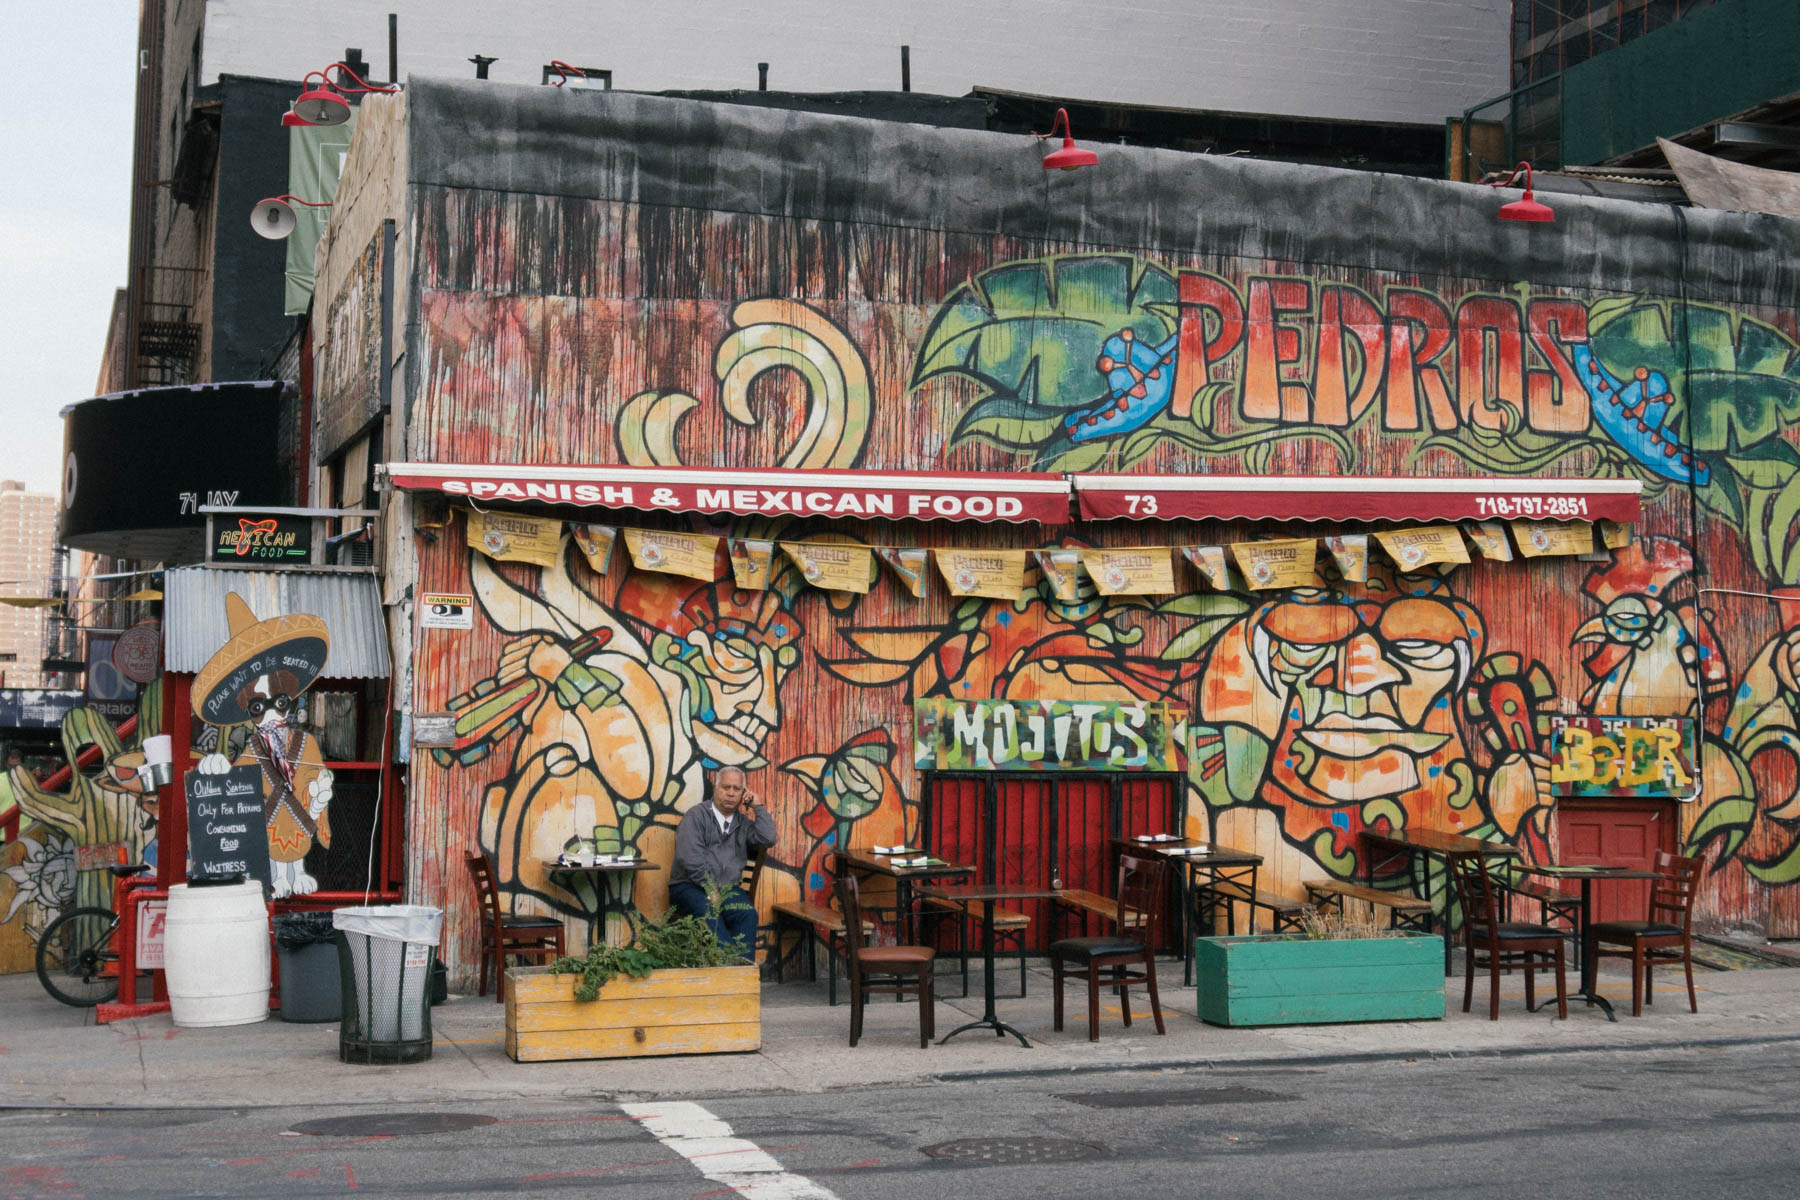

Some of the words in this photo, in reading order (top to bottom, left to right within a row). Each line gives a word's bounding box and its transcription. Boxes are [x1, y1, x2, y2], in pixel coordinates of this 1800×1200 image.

[1169, 270, 1593, 434] PEDROS
[179, 492, 197, 515] 71
[441, 480, 633, 504] SPANISH
[650, 487, 681, 506] &
[696, 488, 893, 514] MEXICAN
[908, 494, 1022, 517] FOOD
[1125, 495, 1158, 515] 73
[1475, 497, 1588, 515] 718-797-2851
[219, 530, 296, 547] MEXICAN
[251, 547, 284, 557] FOOD
[427, 596, 468, 605] WARNING
[208, 688, 231, 716] PLEASE
[250, 661, 262, 673] TO
[282, 656, 309, 669] SEATED
[203, 861, 246, 873] WAITRESS
